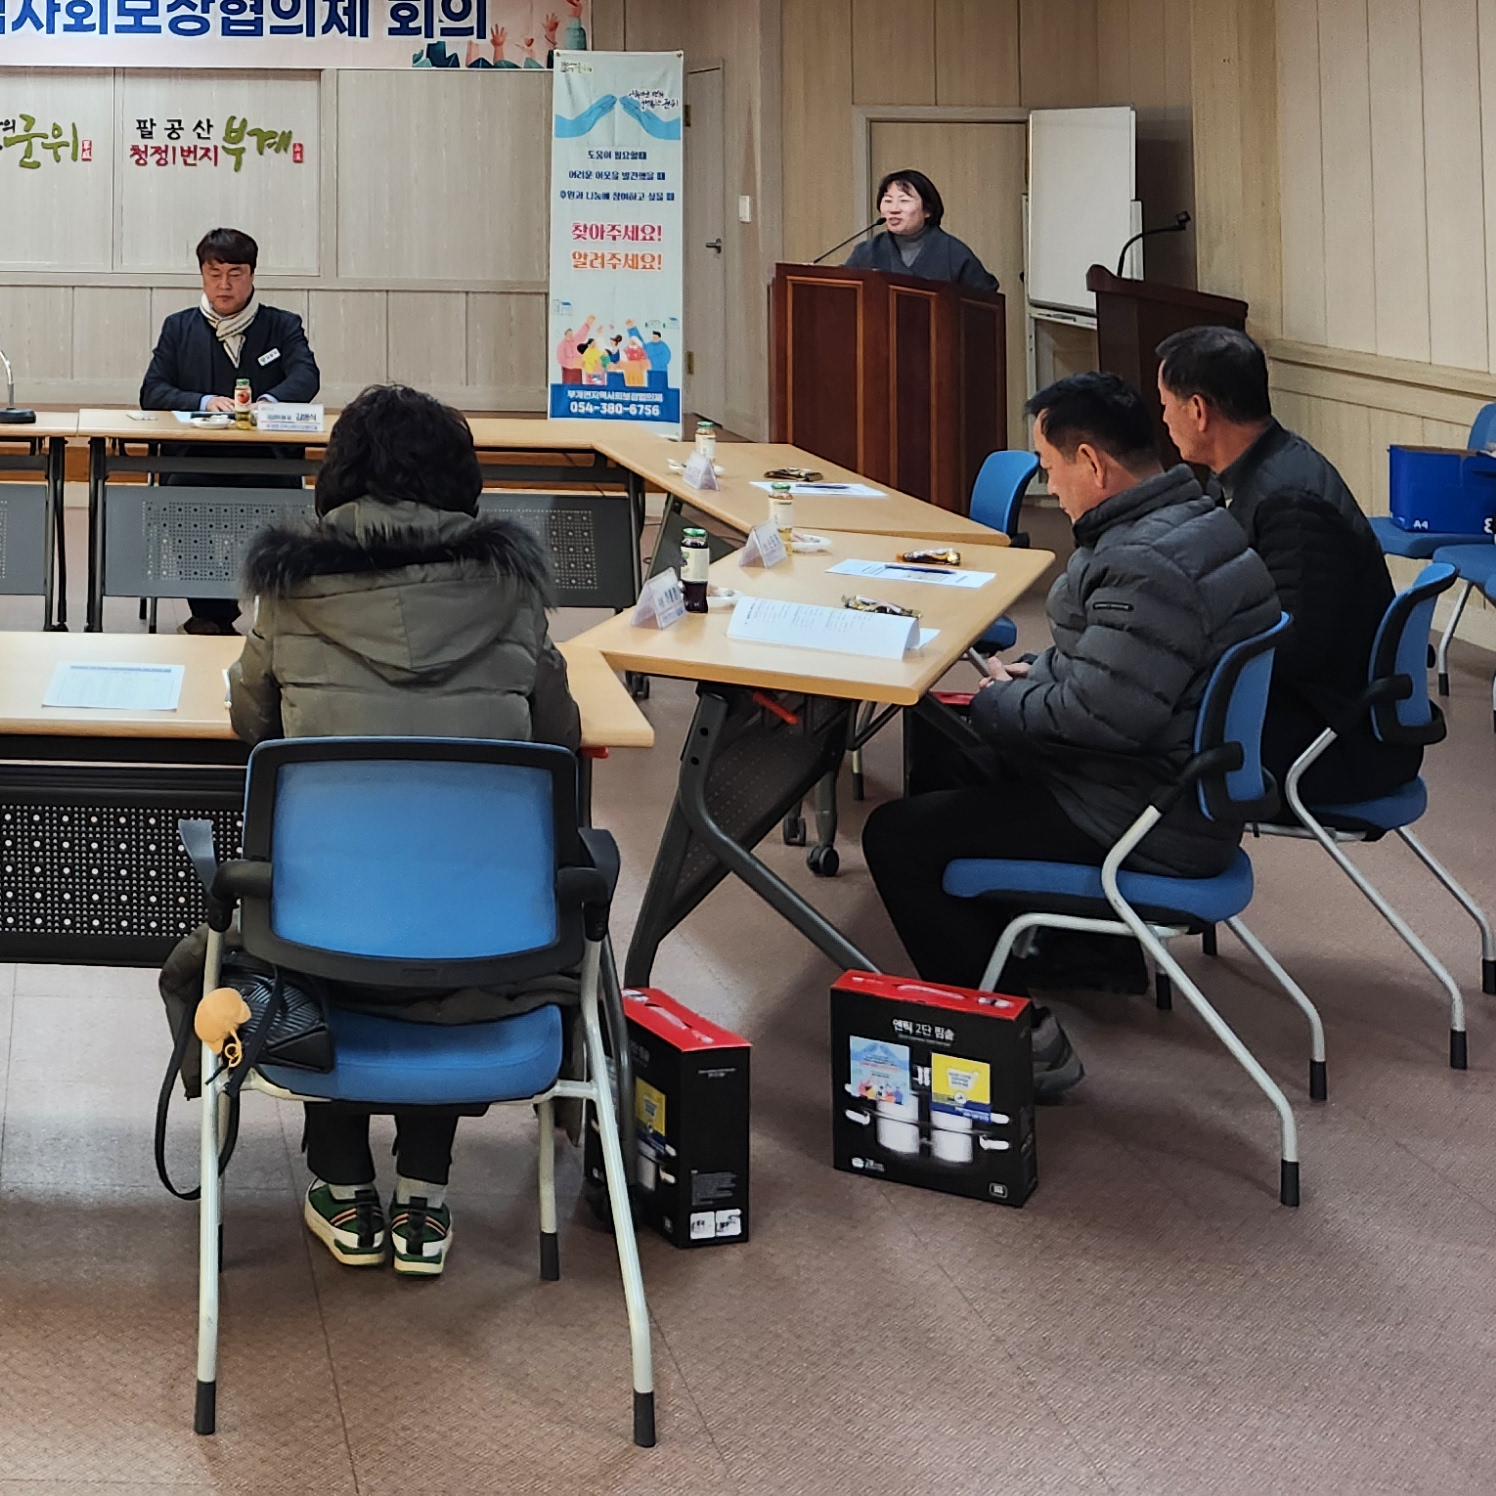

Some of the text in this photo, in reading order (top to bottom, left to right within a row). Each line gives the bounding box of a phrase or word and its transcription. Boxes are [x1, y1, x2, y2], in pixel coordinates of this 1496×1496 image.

[4, 114, 79, 169] 군위
[221, 115, 293, 172] 부계
[571, 222, 662, 243] 찾아주세요!
[571, 250, 662, 271] 알려주세요!
[569, 401, 660, 417] 054-380-6756
[1413, 519, 1429, 530] A4
[915, 1023, 932, 1037] 2단
